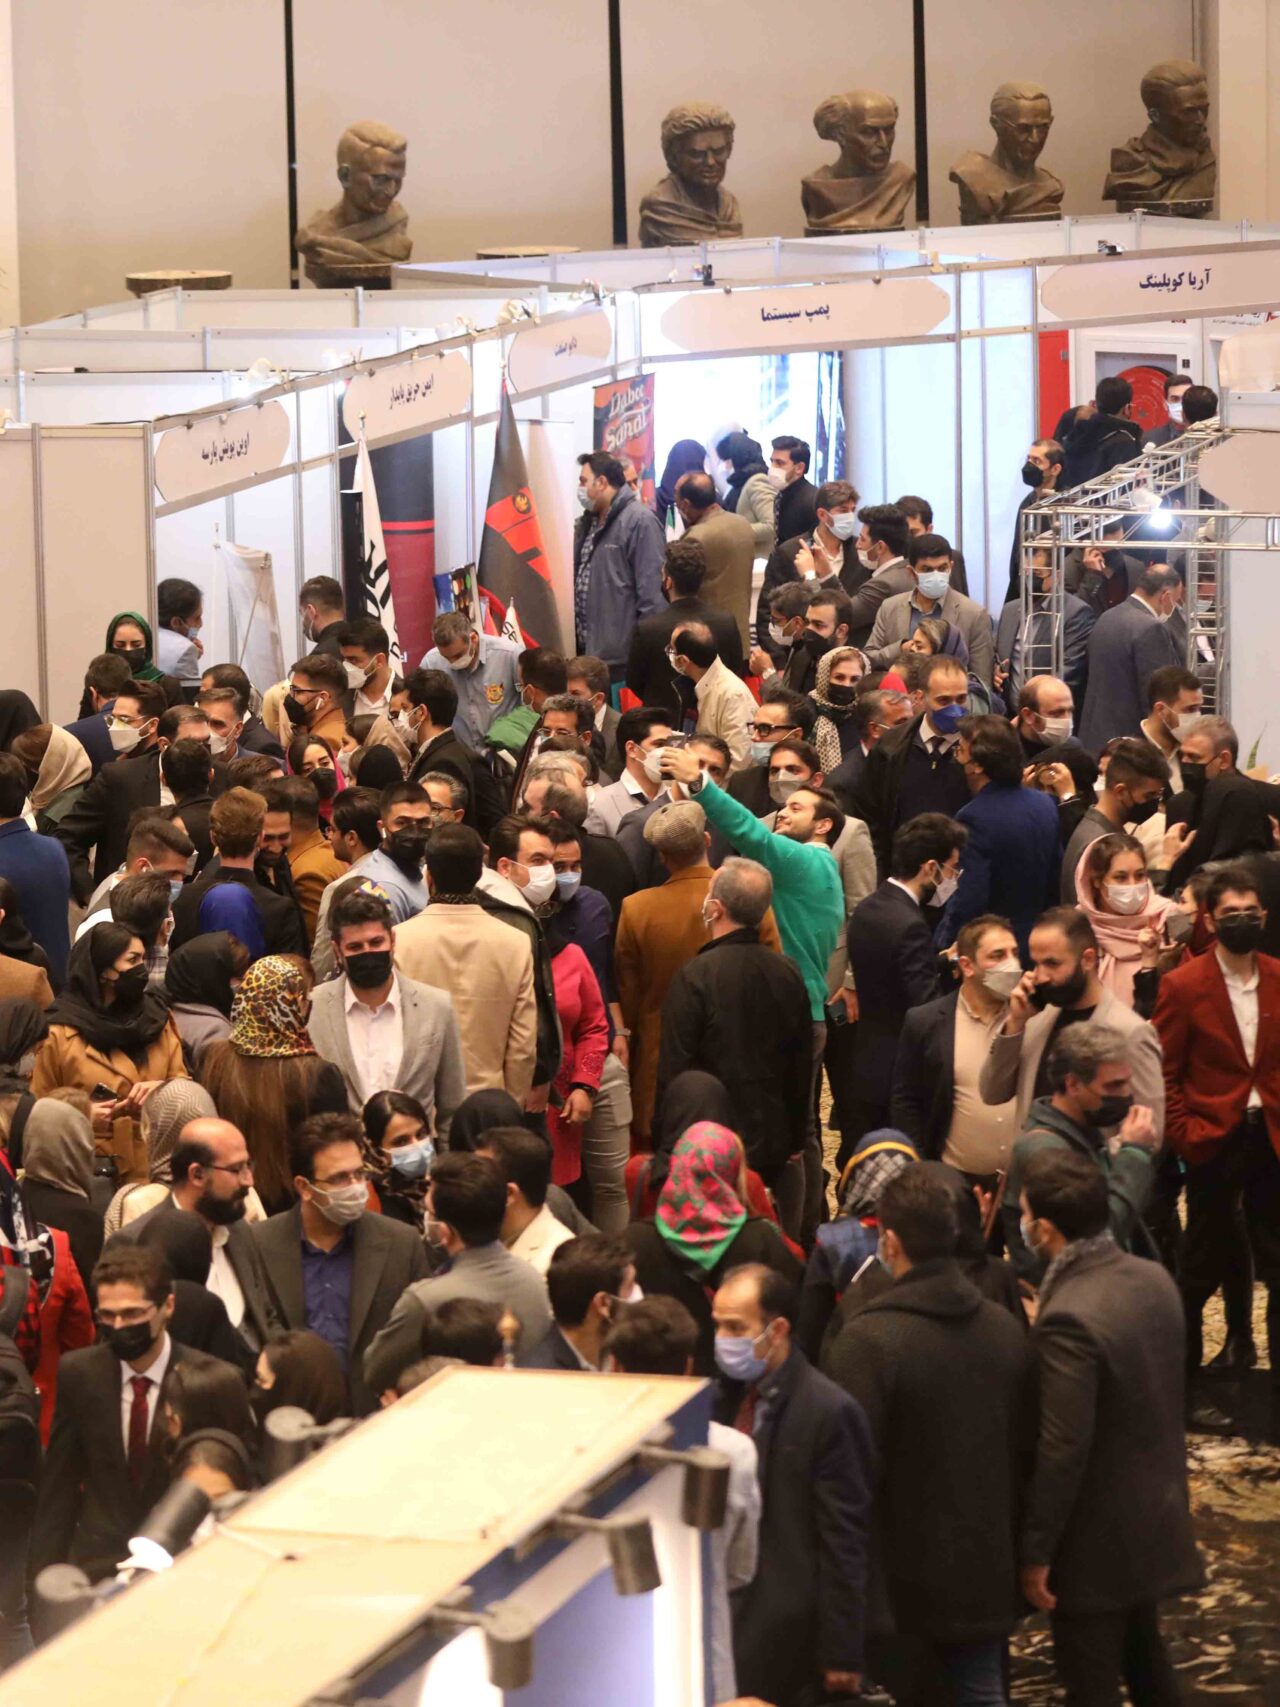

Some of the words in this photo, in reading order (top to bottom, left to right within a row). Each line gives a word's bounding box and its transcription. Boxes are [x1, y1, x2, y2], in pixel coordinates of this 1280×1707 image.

[1139, 271, 1185, 293] کوپلینگ
[1188, 268, 1212, 291] آریا
[761, 306, 801, 323] سیستما
[804, 303, 830, 323] پمپ
